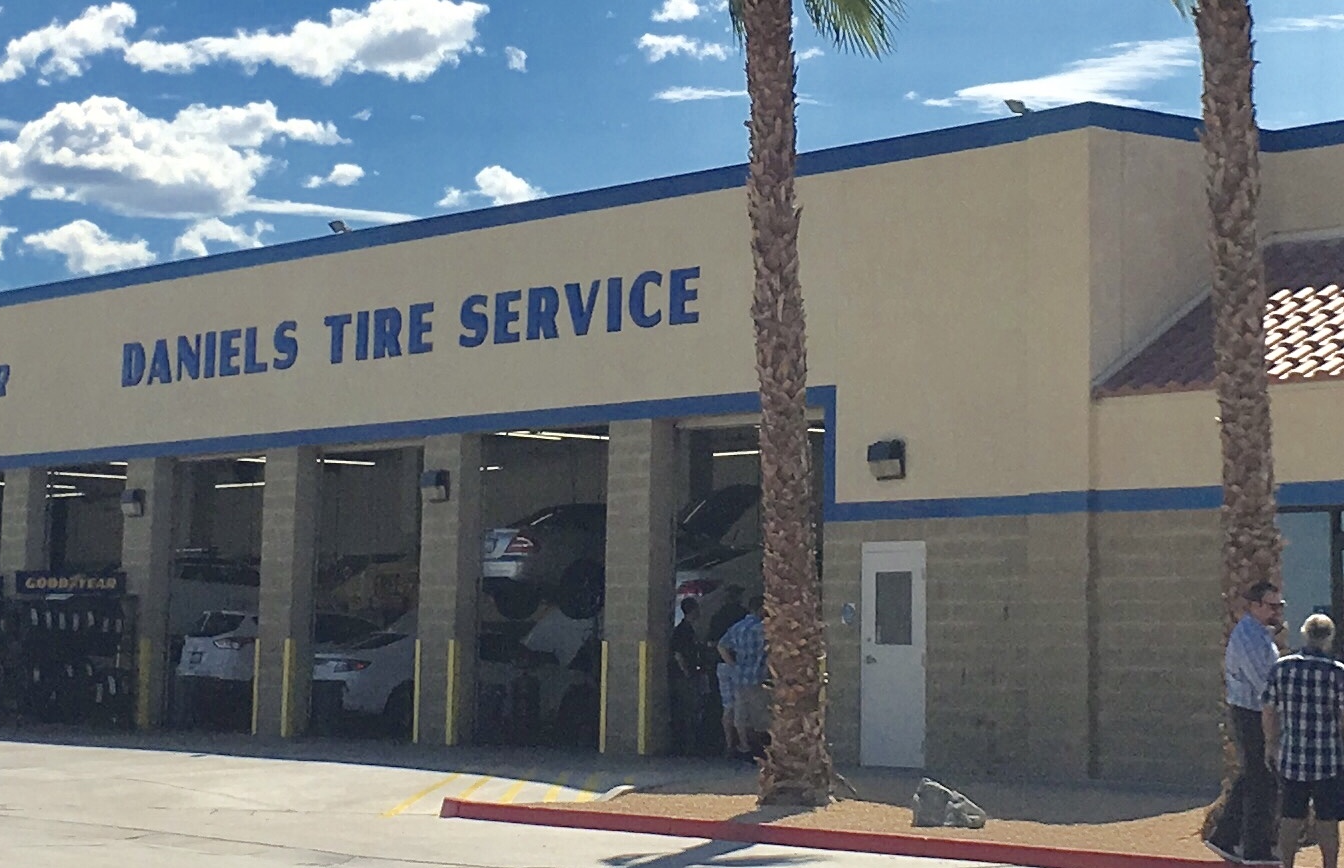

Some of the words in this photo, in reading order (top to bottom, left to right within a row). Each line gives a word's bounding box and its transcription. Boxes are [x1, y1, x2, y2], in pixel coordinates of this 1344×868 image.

[121, 320, 298, 387] DANIELS
[324, 301, 435, 364] TIRE
[458, 265, 701, 348] SERVICE
[25, 573, 117, 590] GOODYEAR
